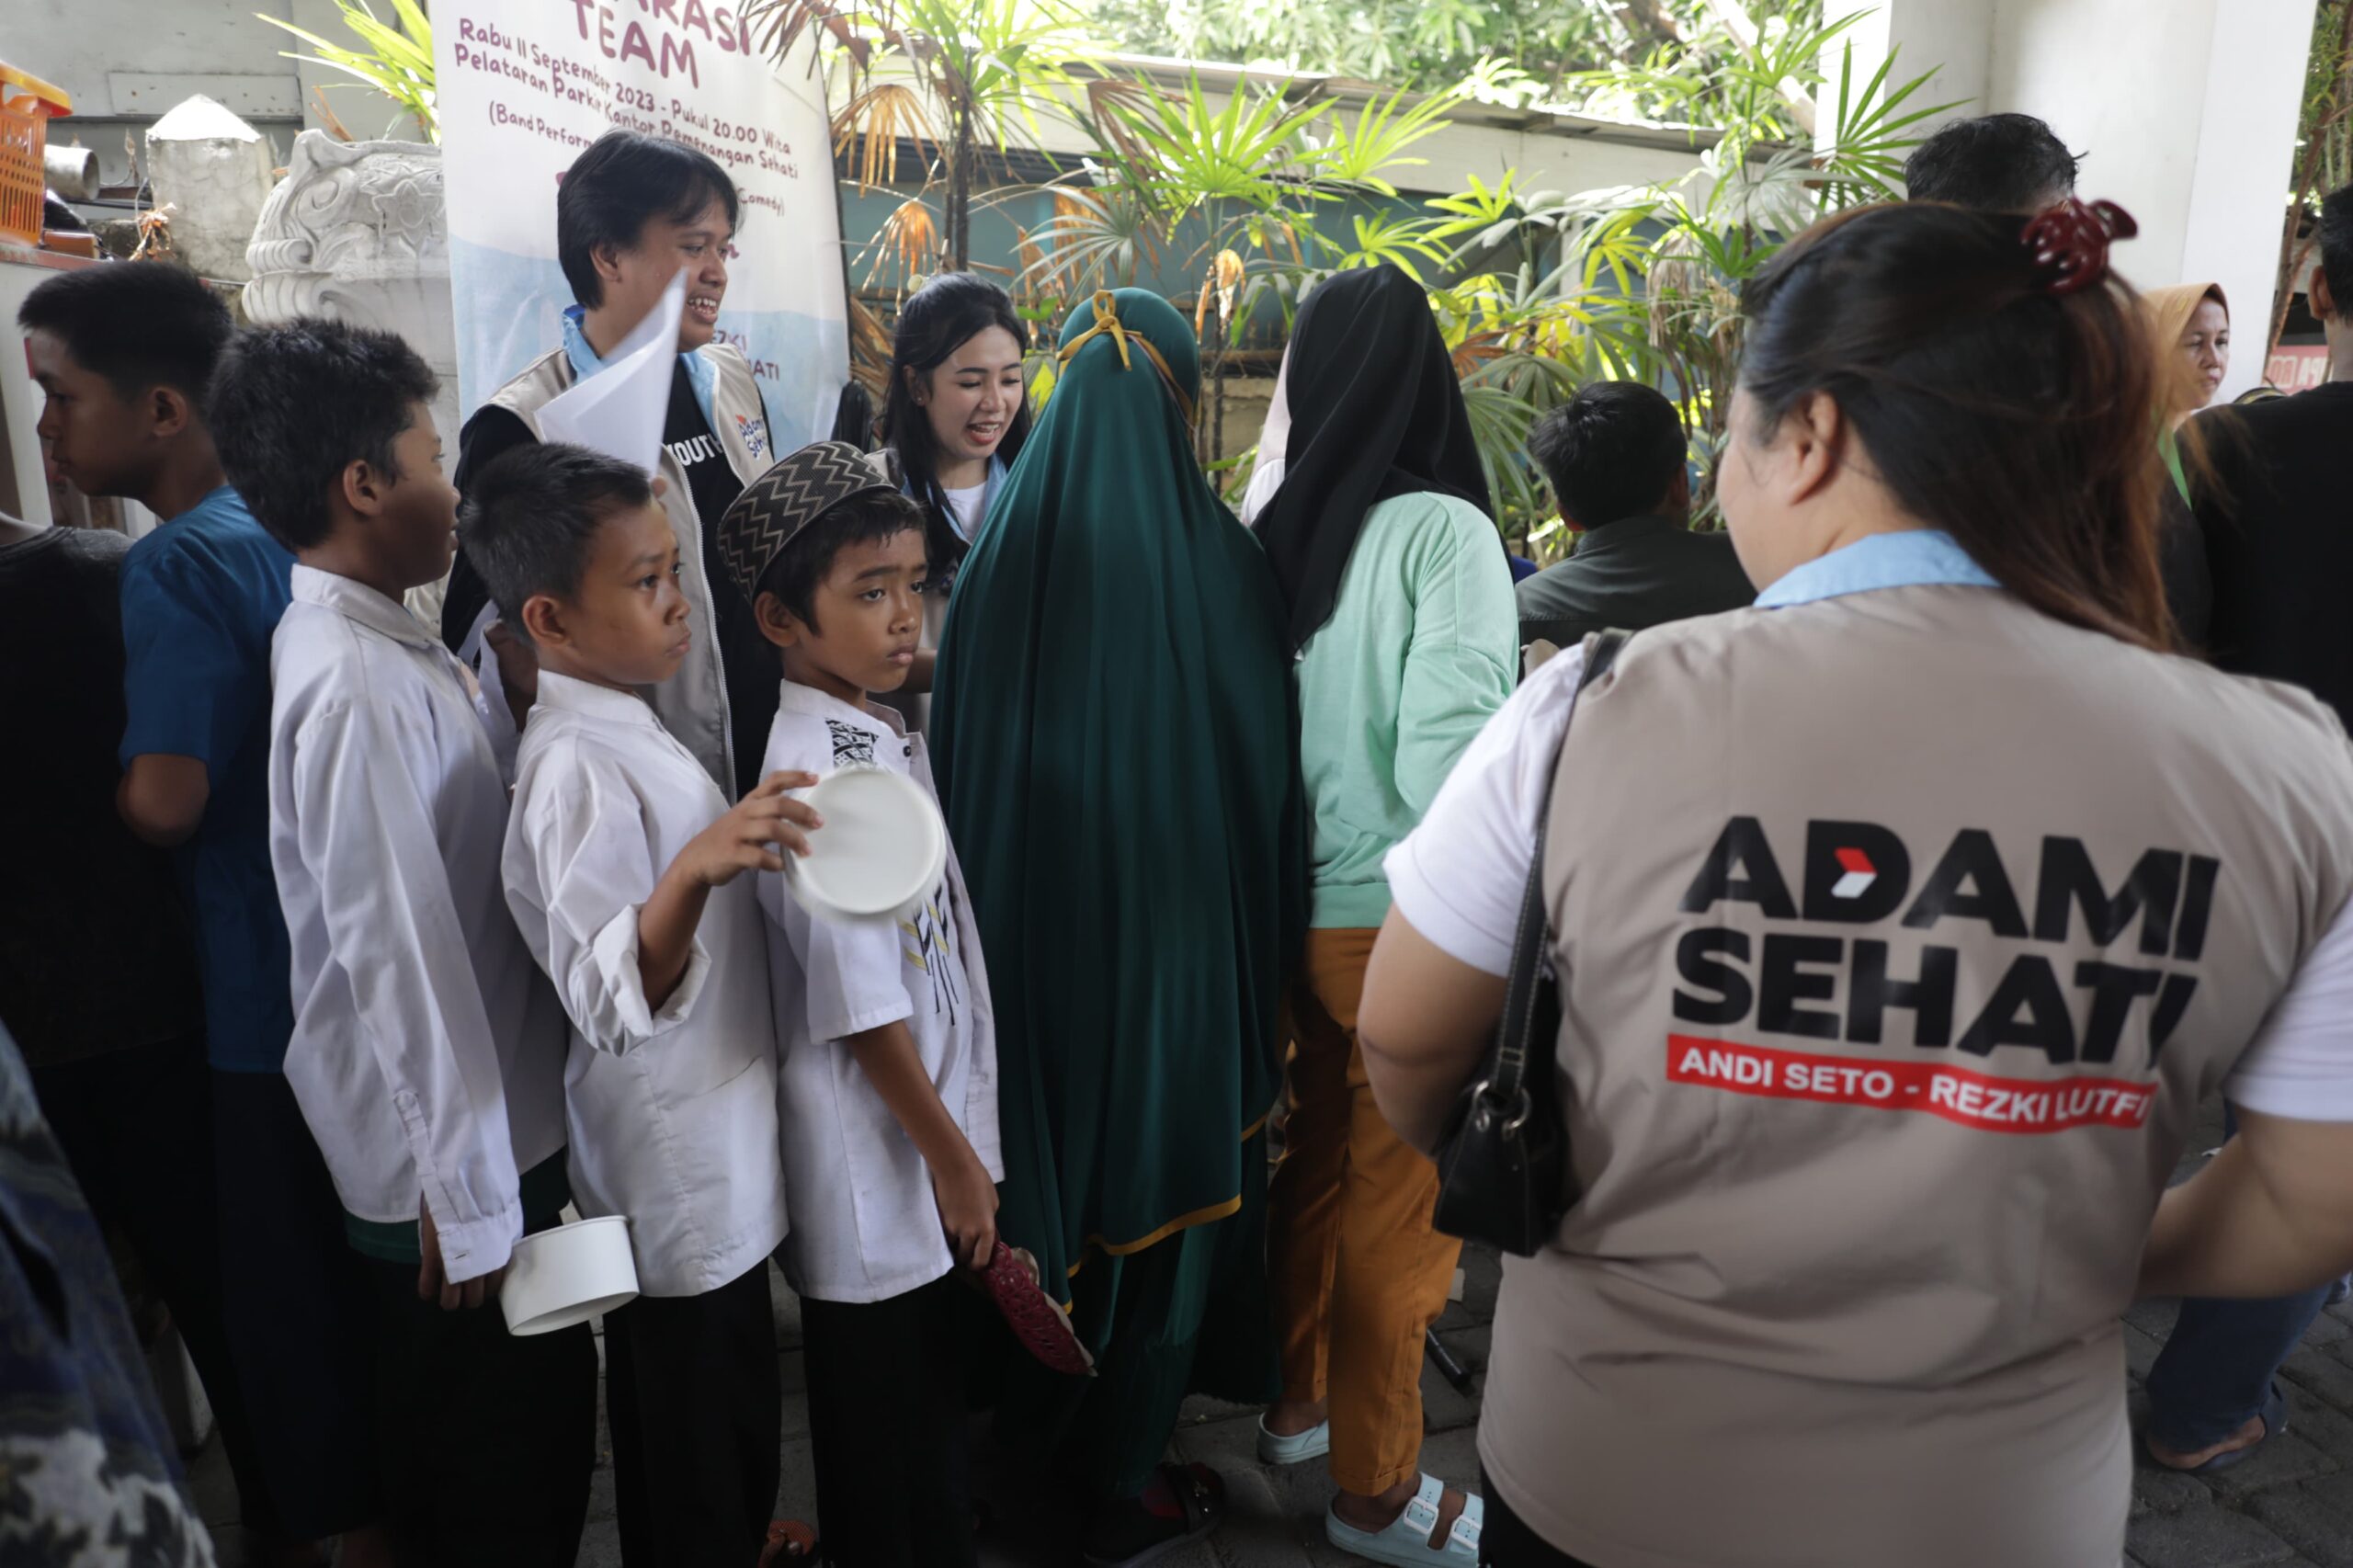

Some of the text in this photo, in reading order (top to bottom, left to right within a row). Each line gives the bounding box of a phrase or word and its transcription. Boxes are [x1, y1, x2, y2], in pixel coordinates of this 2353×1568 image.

[460, 17, 513, 51] Rabu
[530, 43, 611, 95] September
[615, 82, 655, 112] 2023
[671, 99, 710, 131] Pukul
[712, 118, 758, 143] 20.00
[570, 0, 699, 89] TEAM
[454, 42, 549, 93] Pelataran
[551, 75, 602, 113] Parkir
[603, 101, 656, 134] Kantor
[758, 150, 799, 179] Sehati
[489, 100, 534, 131] (Band
[1677, 814, 2222, 961] ADAMI
[1672, 926, 2200, 1072] SEHATI
[1678, 1047, 1773, 1087] ANDI
[1783, 1062, 1894, 1098] SETO
[1929, 1074, 2049, 1123] REZKI
[2054, 1085, 2151, 1122] LUTFI
